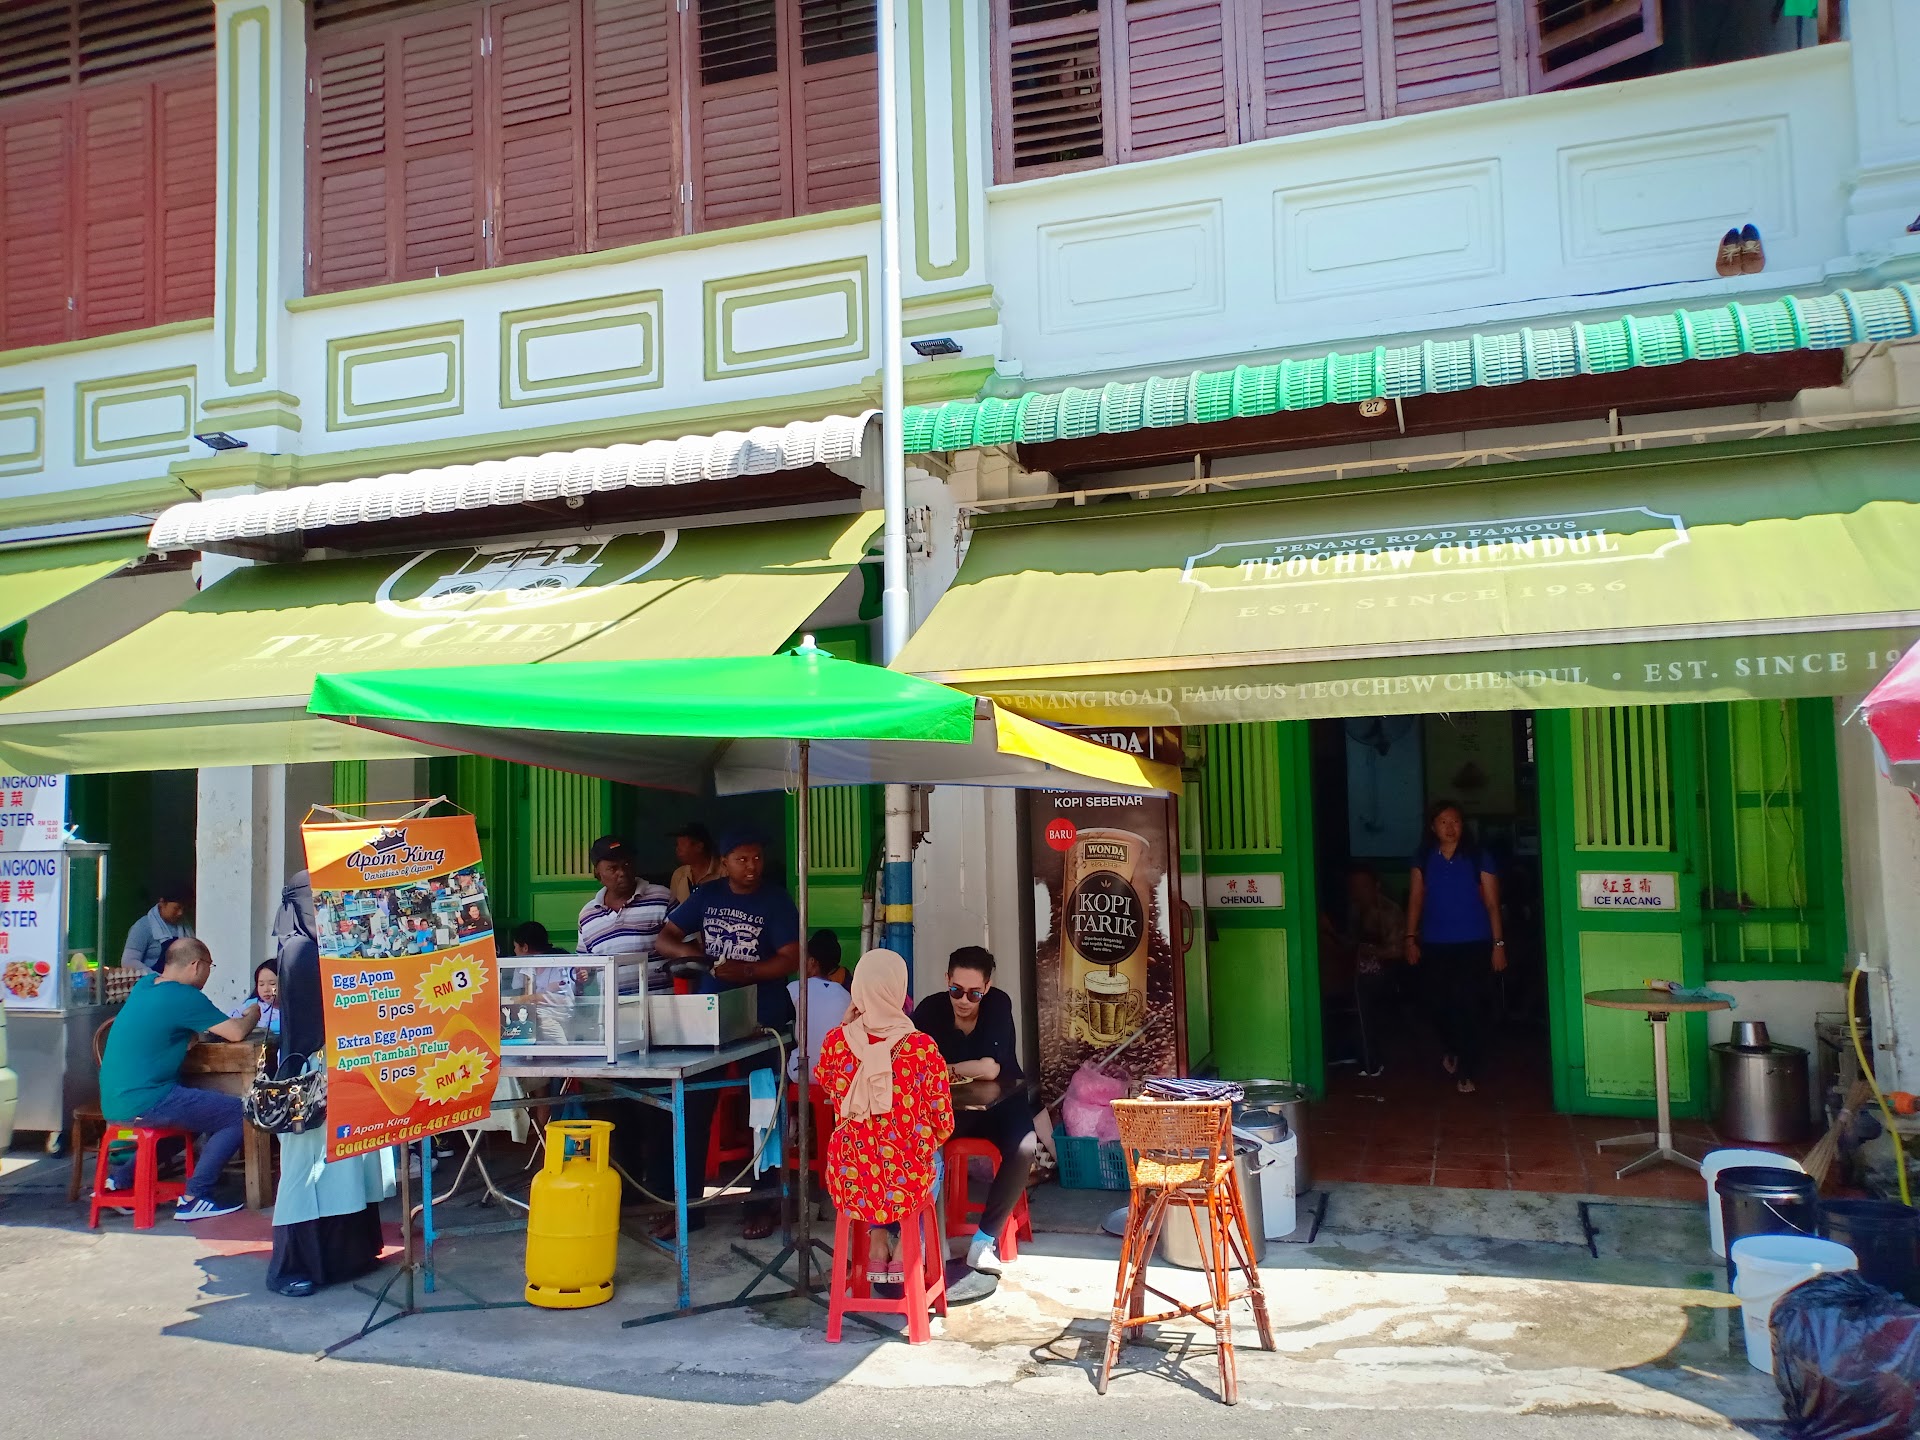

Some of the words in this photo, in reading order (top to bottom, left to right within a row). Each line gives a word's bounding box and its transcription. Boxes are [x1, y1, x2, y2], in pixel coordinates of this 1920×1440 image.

[1366, 401, 1379, 413] 27
[1274, 537, 1376, 554] PENANG
[1386, 531, 1457, 544] ROAD
[1468, 520, 1577, 538] FAMOUS
[1240, 544, 1418, 582] TEOCHEW
[1432, 528, 1619, 566] CHENDUL
[1236, 602, 1331, 618] EST.
[1356, 589, 1499, 609] SINCE
[1520, 579, 1627, 598] 1936
[1000, 692, 1096, 711] PENANG
[1103, 687, 1173, 709] ROAD
[1180, 683, 1286, 703] FAMOUS
[1298, 675, 1437, 700] TEOCHEW
[1443, 667, 1588, 692] CHENDUL
[1644, 660, 1718, 683] EST.
[1735, 652, 1848, 678] SINCE
[1866, 649, 1901, 670] 19
[0, 774, 57, 789] NGKONG
[1054, 797, 1083, 808] KOPI
[1086, 795, 1143, 807] SEBENAR
[0, 813, 34, 827] STER
[1049, 829, 1073, 839] BARU
[347, 851, 397, 872] Apom
[400, 846, 445, 865] King
[1087, 844, 1125, 856] WONDA
[364, 869, 400, 881] Varieties
[401, 867, 410, 876] of
[411, 864, 433, 874] Apom
[1079, 893, 1132, 916] KOPI
[1220, 895, 1265, 905] CHENDUL
[1594, 896, 1611, 905] ICE
[1614, 896, 1662, 906] KACANG
[748, 914, 754, 923] &
[754, 916, 765, 925] CO.
[1071, 914, 1137, 938] TARIK
[333, 974, 357, 989] Egg
[359, 970, 395, 986] Apom
[433, 981, 454, 998] RM
[455, 971, 468, 988] 3
[334, 994, 367, 1008] Apom
[371, 987, 401, 1000] Telur
[378, 1005, 386, 1018] 5
[390, 1003, 415, 1019] pcs
[337, 1036, 371, 1050] Extra
[374, 1030, 397, 1045] Egg
[400, 1025, 433, 1040] Apom
[337, 1056, 371, 1071] Apom
[374, 1047, 417, 1063] Tambah
[420, 1041, 449, 1054] Telur
[380, 1068, 388, 1081] 5
[392, 1065, 416, 1082] pcs
[436, 1071, 456, 1089] RM
[335, 1132, 390, 1157] Contact
[398, 1114, 450, 1140] 016-487
[451, 1105, 482, 1125] 9070
[353, 1122, 384, 1136] Apom
[386, 1116, 411, 1129] King
